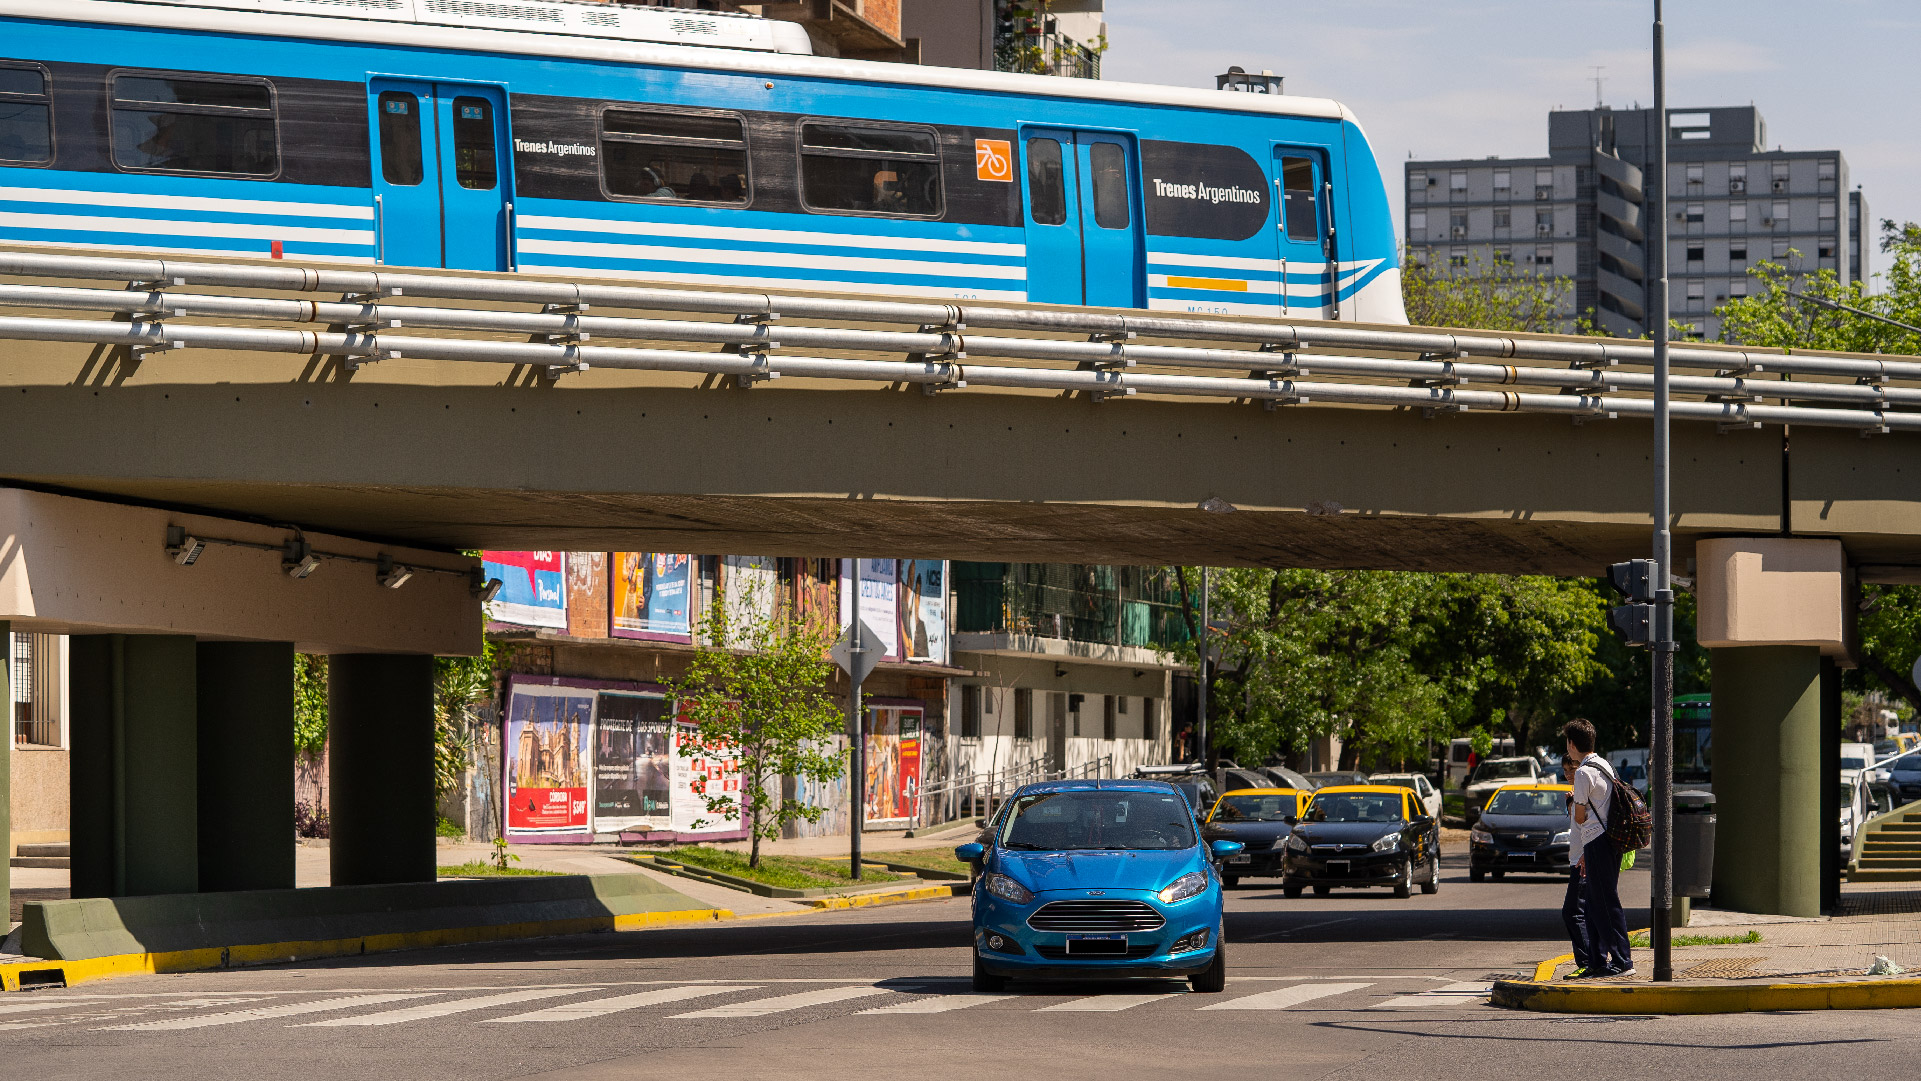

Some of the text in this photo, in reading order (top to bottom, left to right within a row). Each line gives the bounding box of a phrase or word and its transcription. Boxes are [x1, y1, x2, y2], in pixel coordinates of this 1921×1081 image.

[514, 139, 596, 156] Trenes Argentinos
[1153, 178, 1261, 204] Trenes Argentinos
[538, 579, 560, 604] Personal
